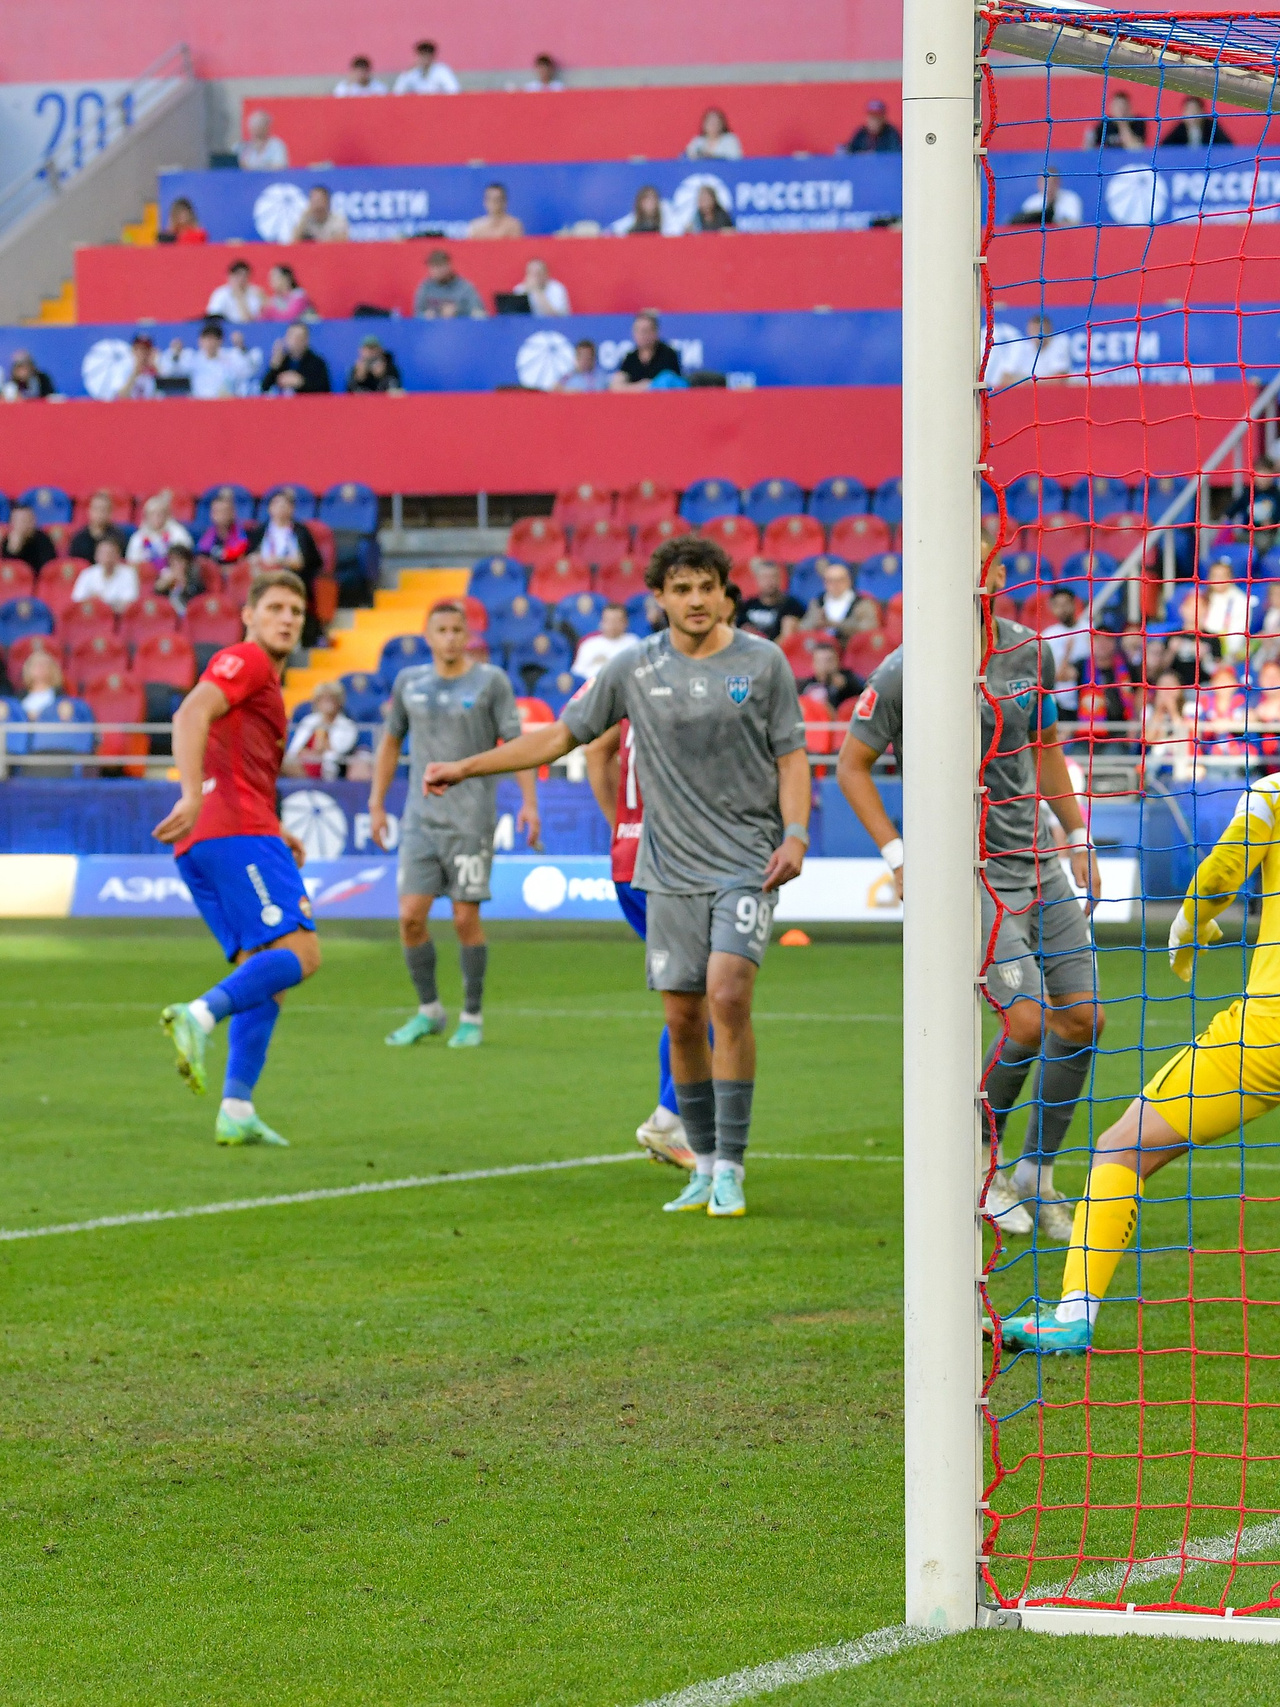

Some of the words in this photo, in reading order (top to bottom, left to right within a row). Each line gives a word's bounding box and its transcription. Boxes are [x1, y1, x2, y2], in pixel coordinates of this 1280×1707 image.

[331, 189, 429, 220] ОССЕТИ
[735, 180, 854, 211] РОССЕТИ
[453, 854, 485, 887] 70
[735, 895, 770, 941] 99
